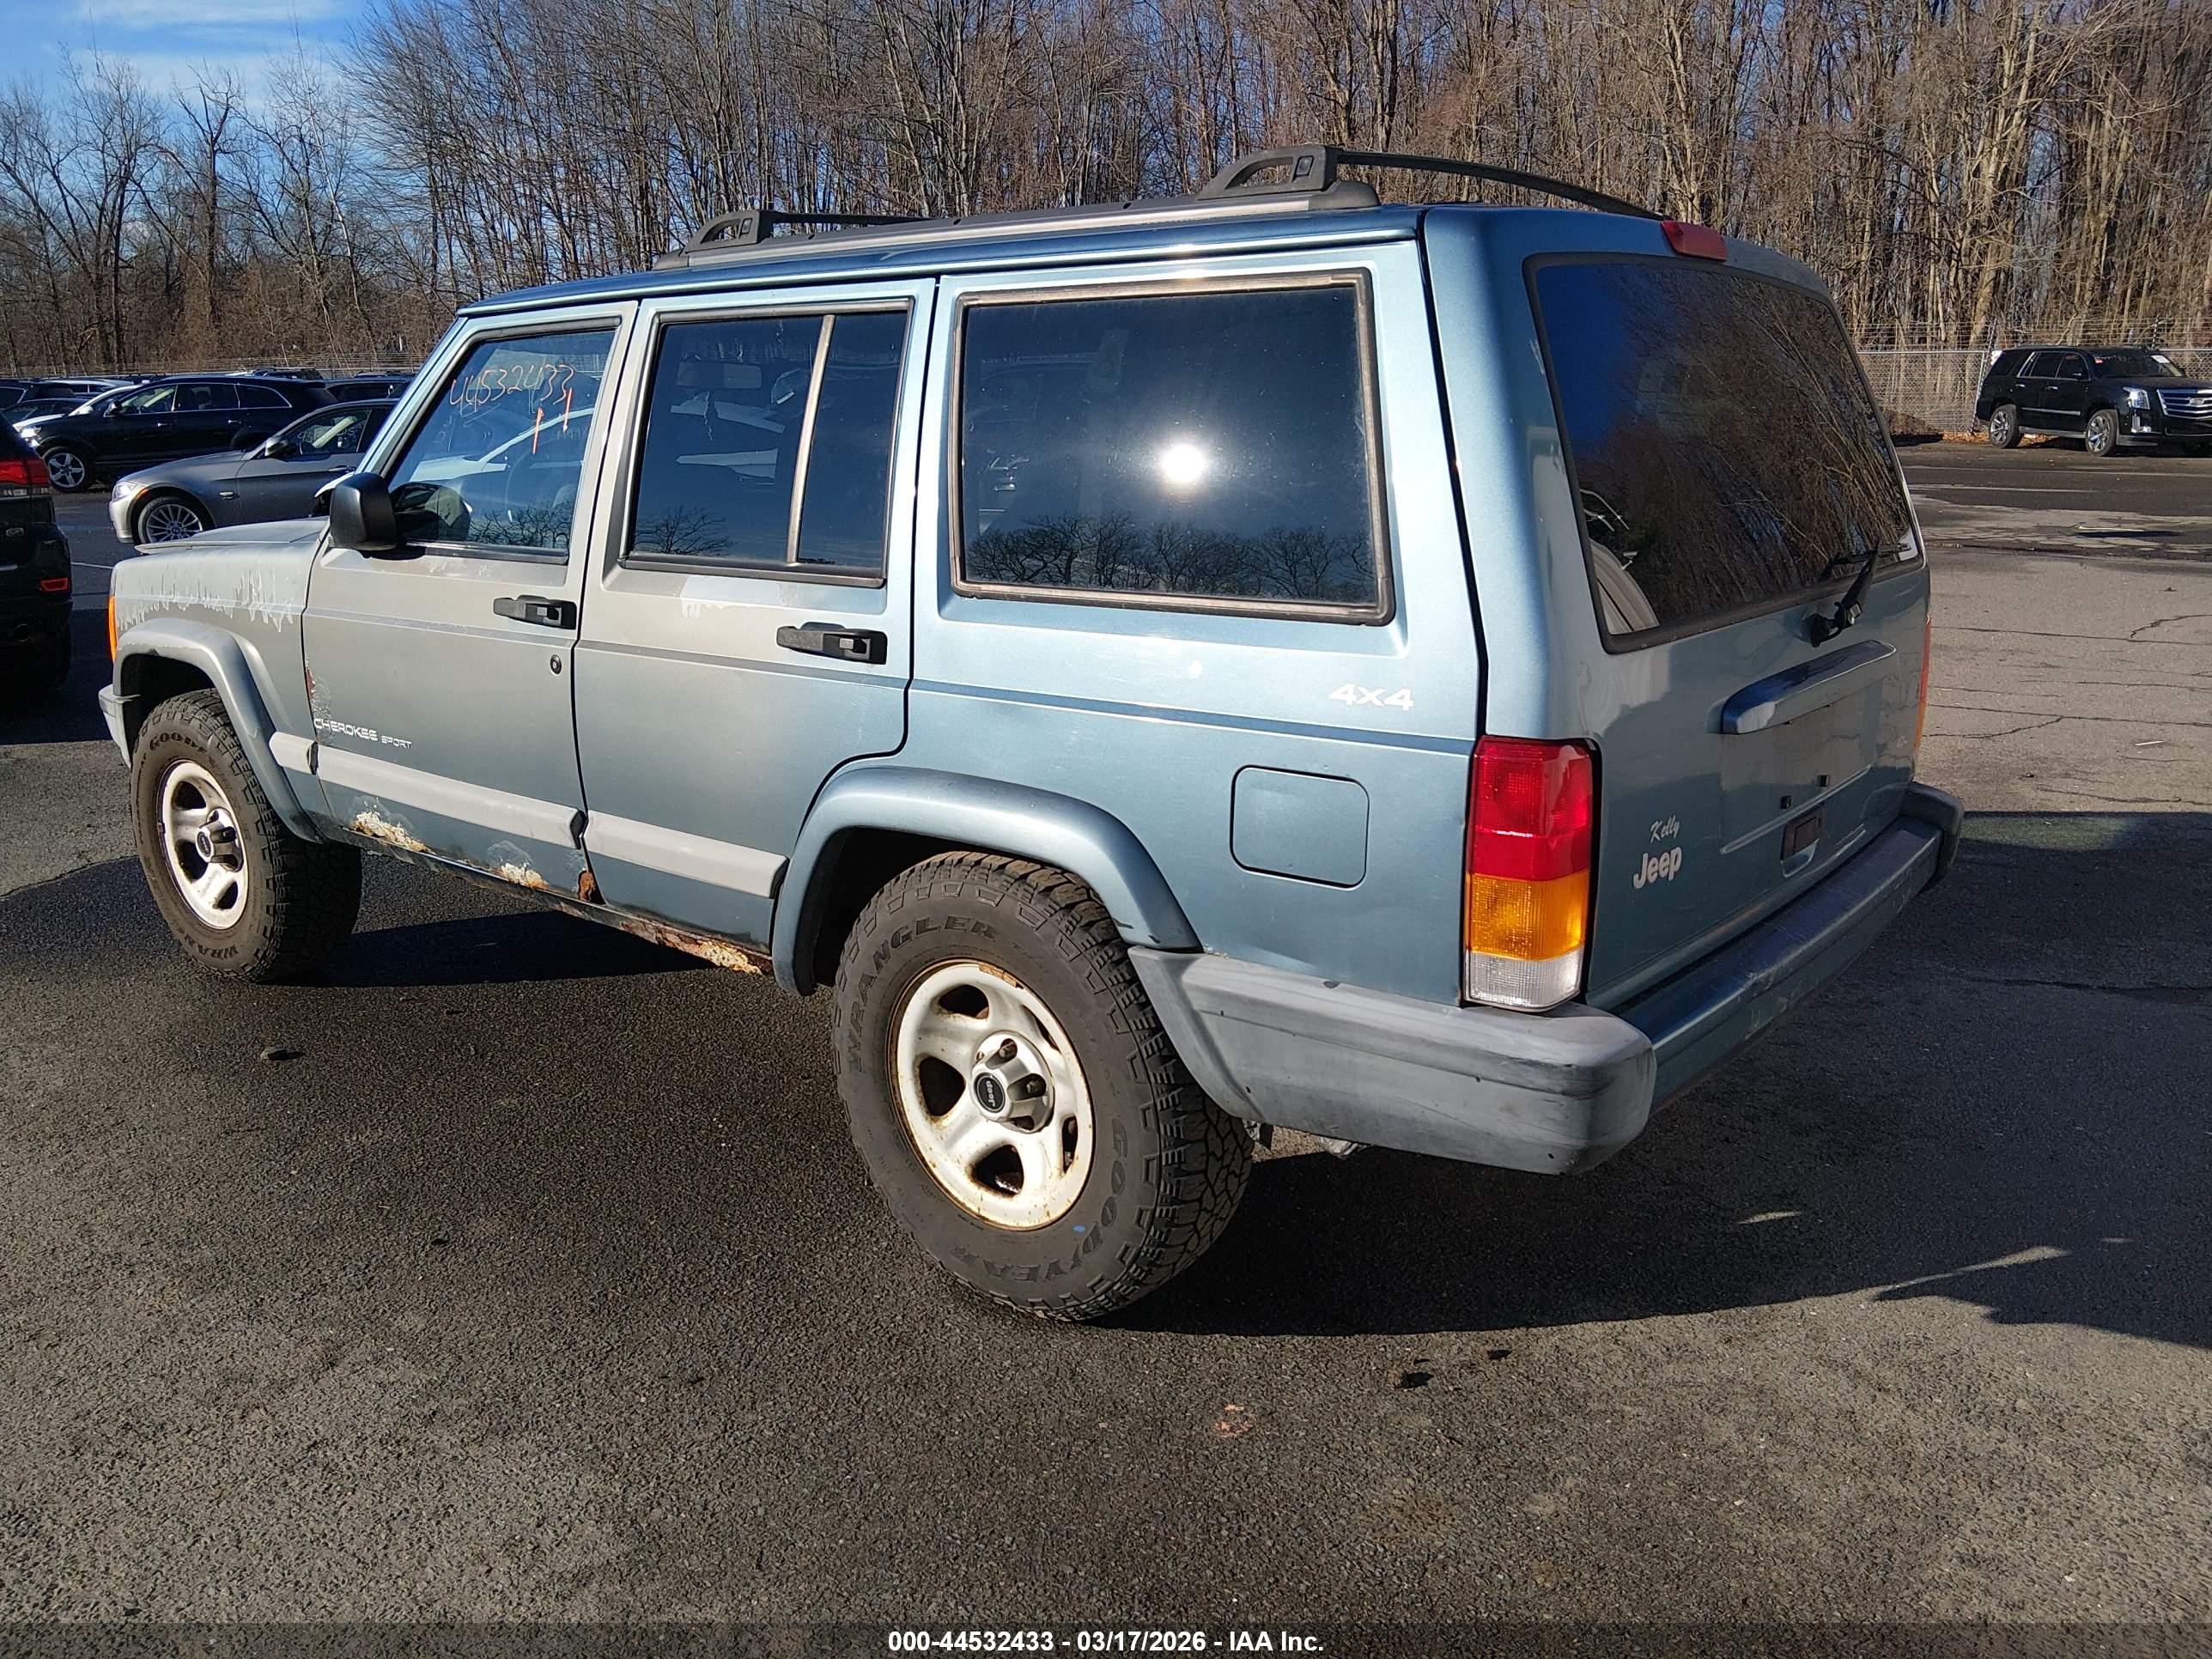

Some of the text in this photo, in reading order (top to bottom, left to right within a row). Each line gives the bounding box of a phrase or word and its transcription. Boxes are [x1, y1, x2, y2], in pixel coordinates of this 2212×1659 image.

[449, 362, 574, 416] 44532433
[313, 718, 412, 749] CHEROKEE SPORT
[1650, 815, 1680, 843] Kelly
[1633, 847, 1682, 889] Jeep
